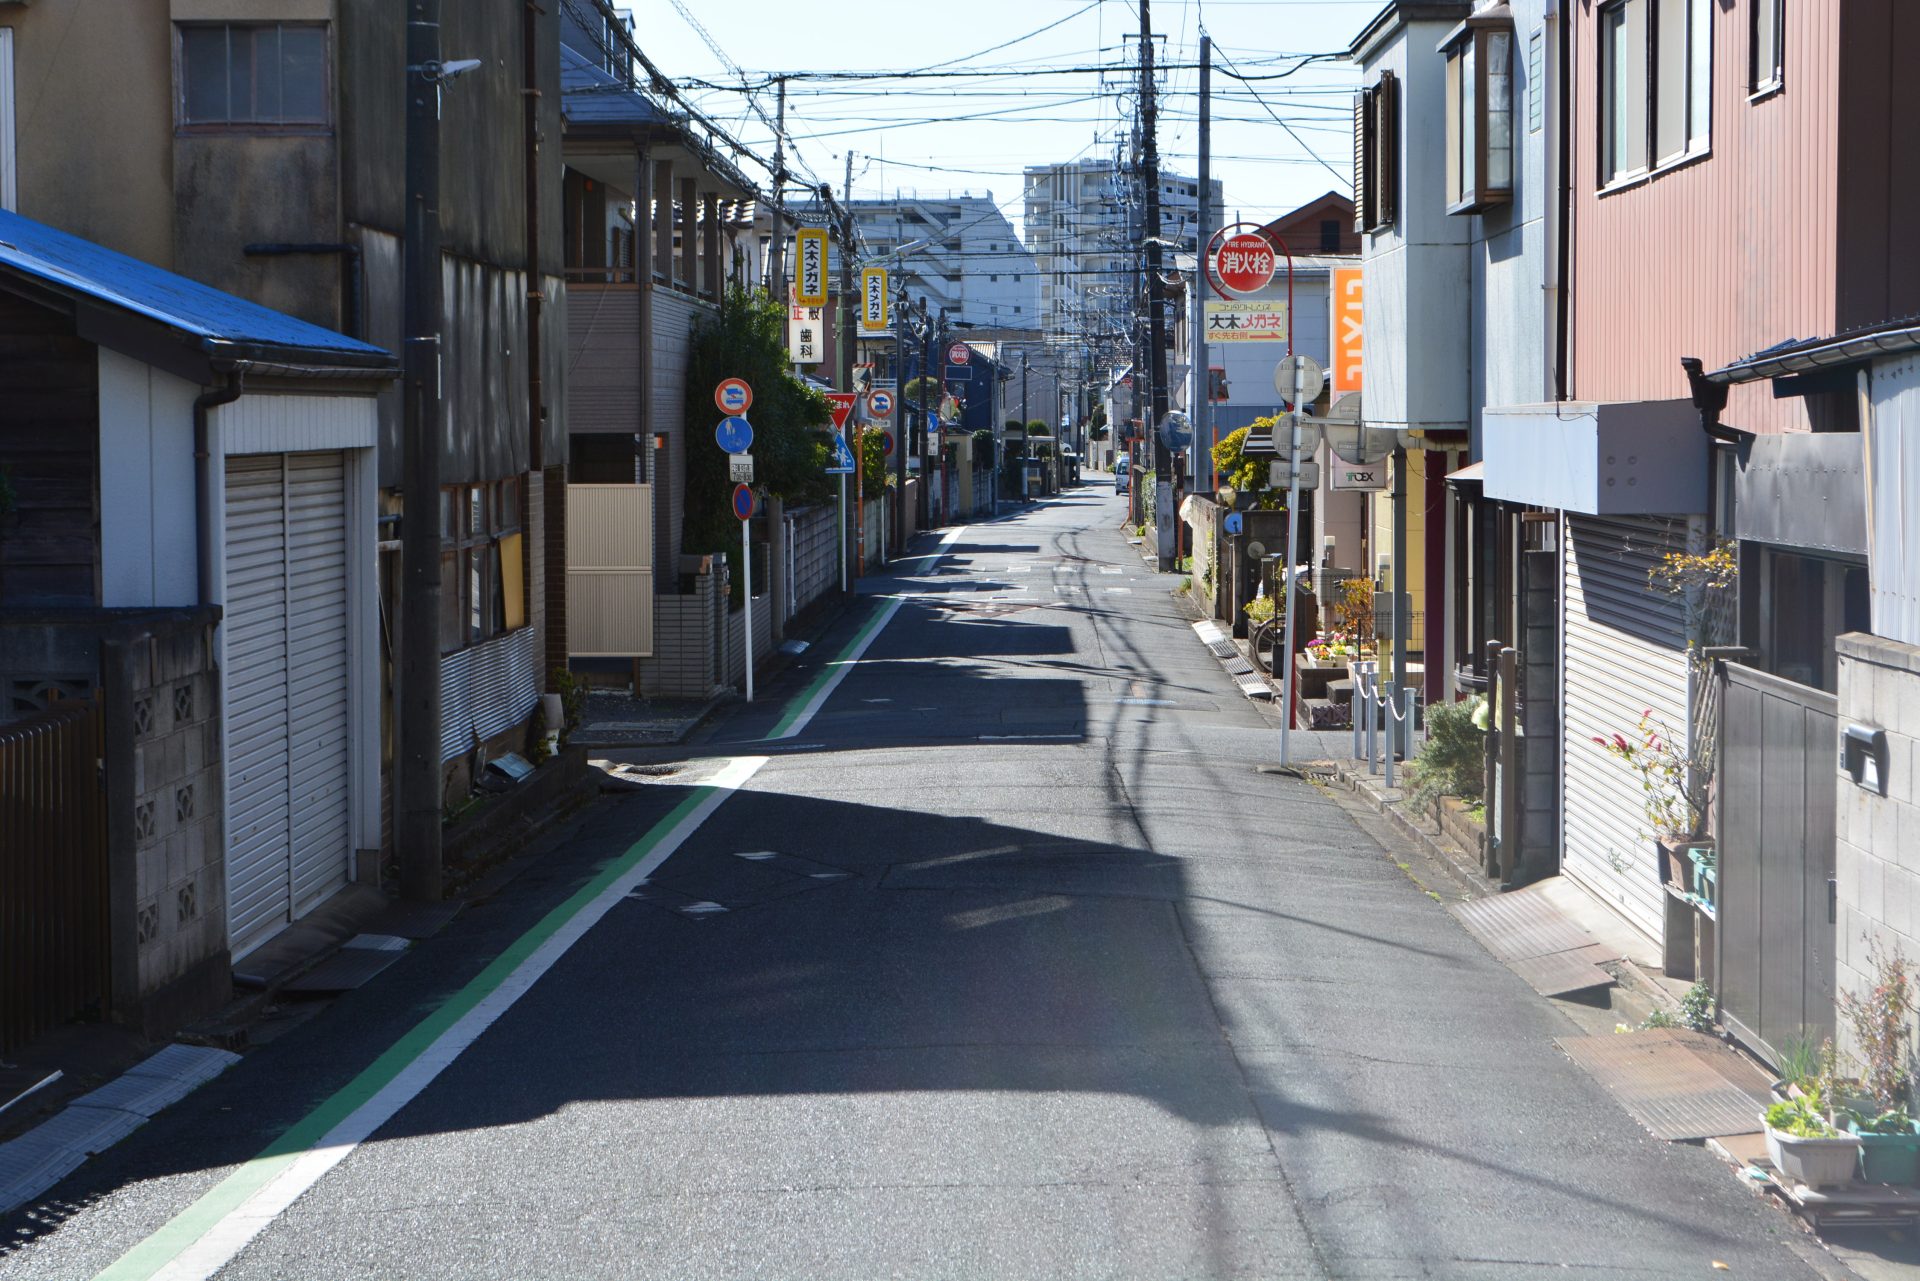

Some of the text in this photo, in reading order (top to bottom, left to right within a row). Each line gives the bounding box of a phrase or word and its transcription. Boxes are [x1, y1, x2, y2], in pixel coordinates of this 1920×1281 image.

[1240, 241, 1265, 249] HYDRANT
[804, 239, 819, 295] 大木メガネ
[1222, 251, 1271, 274] 消火栓
[868, 276, 880, 321] 大木メガネ
[1209, 313, 1281, 329] 大木メガネ
[800, 328, 813, 359] 歯科
[1208, 331, 1248, 339] すぐ先右側
